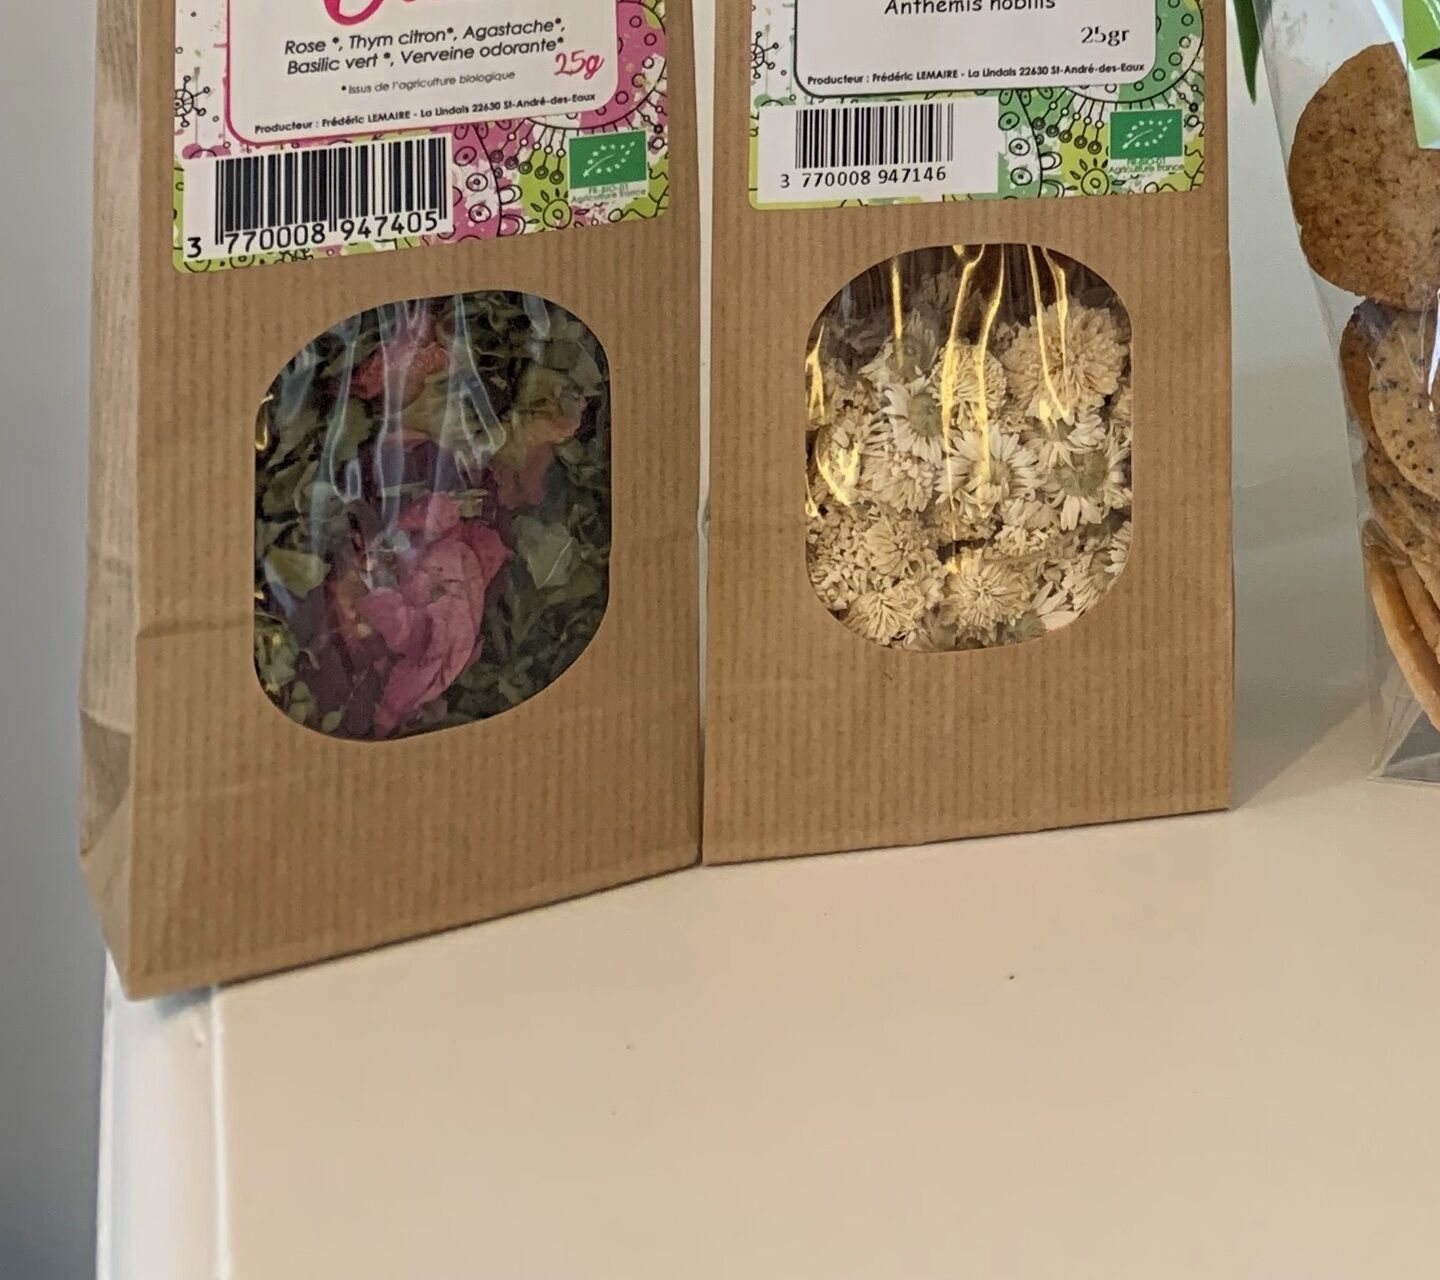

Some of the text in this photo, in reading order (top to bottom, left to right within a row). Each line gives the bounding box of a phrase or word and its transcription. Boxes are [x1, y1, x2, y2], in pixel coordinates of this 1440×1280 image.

[284, 41, 326, 55] Rose
[350, 34, 392, 52] Thym
[1080, 26, 1131, 47] 25gr
[287, 58, 340, 75] Basilic
[346, 56, 378, 70] vert
[400, 44, 481, 65] Verveine
[554, 50, 605, 80] 25g
[807, 75, 864, 85] Producteur
[872, 72, 913, 82] Frédéric
[916, 70, 958, 80] LEMAIRE
[968, 70, 980, 78] La
[1019, 66, 1048, 75] 22630
[781, 167, 946, 188] 3 770008 947146
[187, 211, 438, 258] 3 770008 947405
